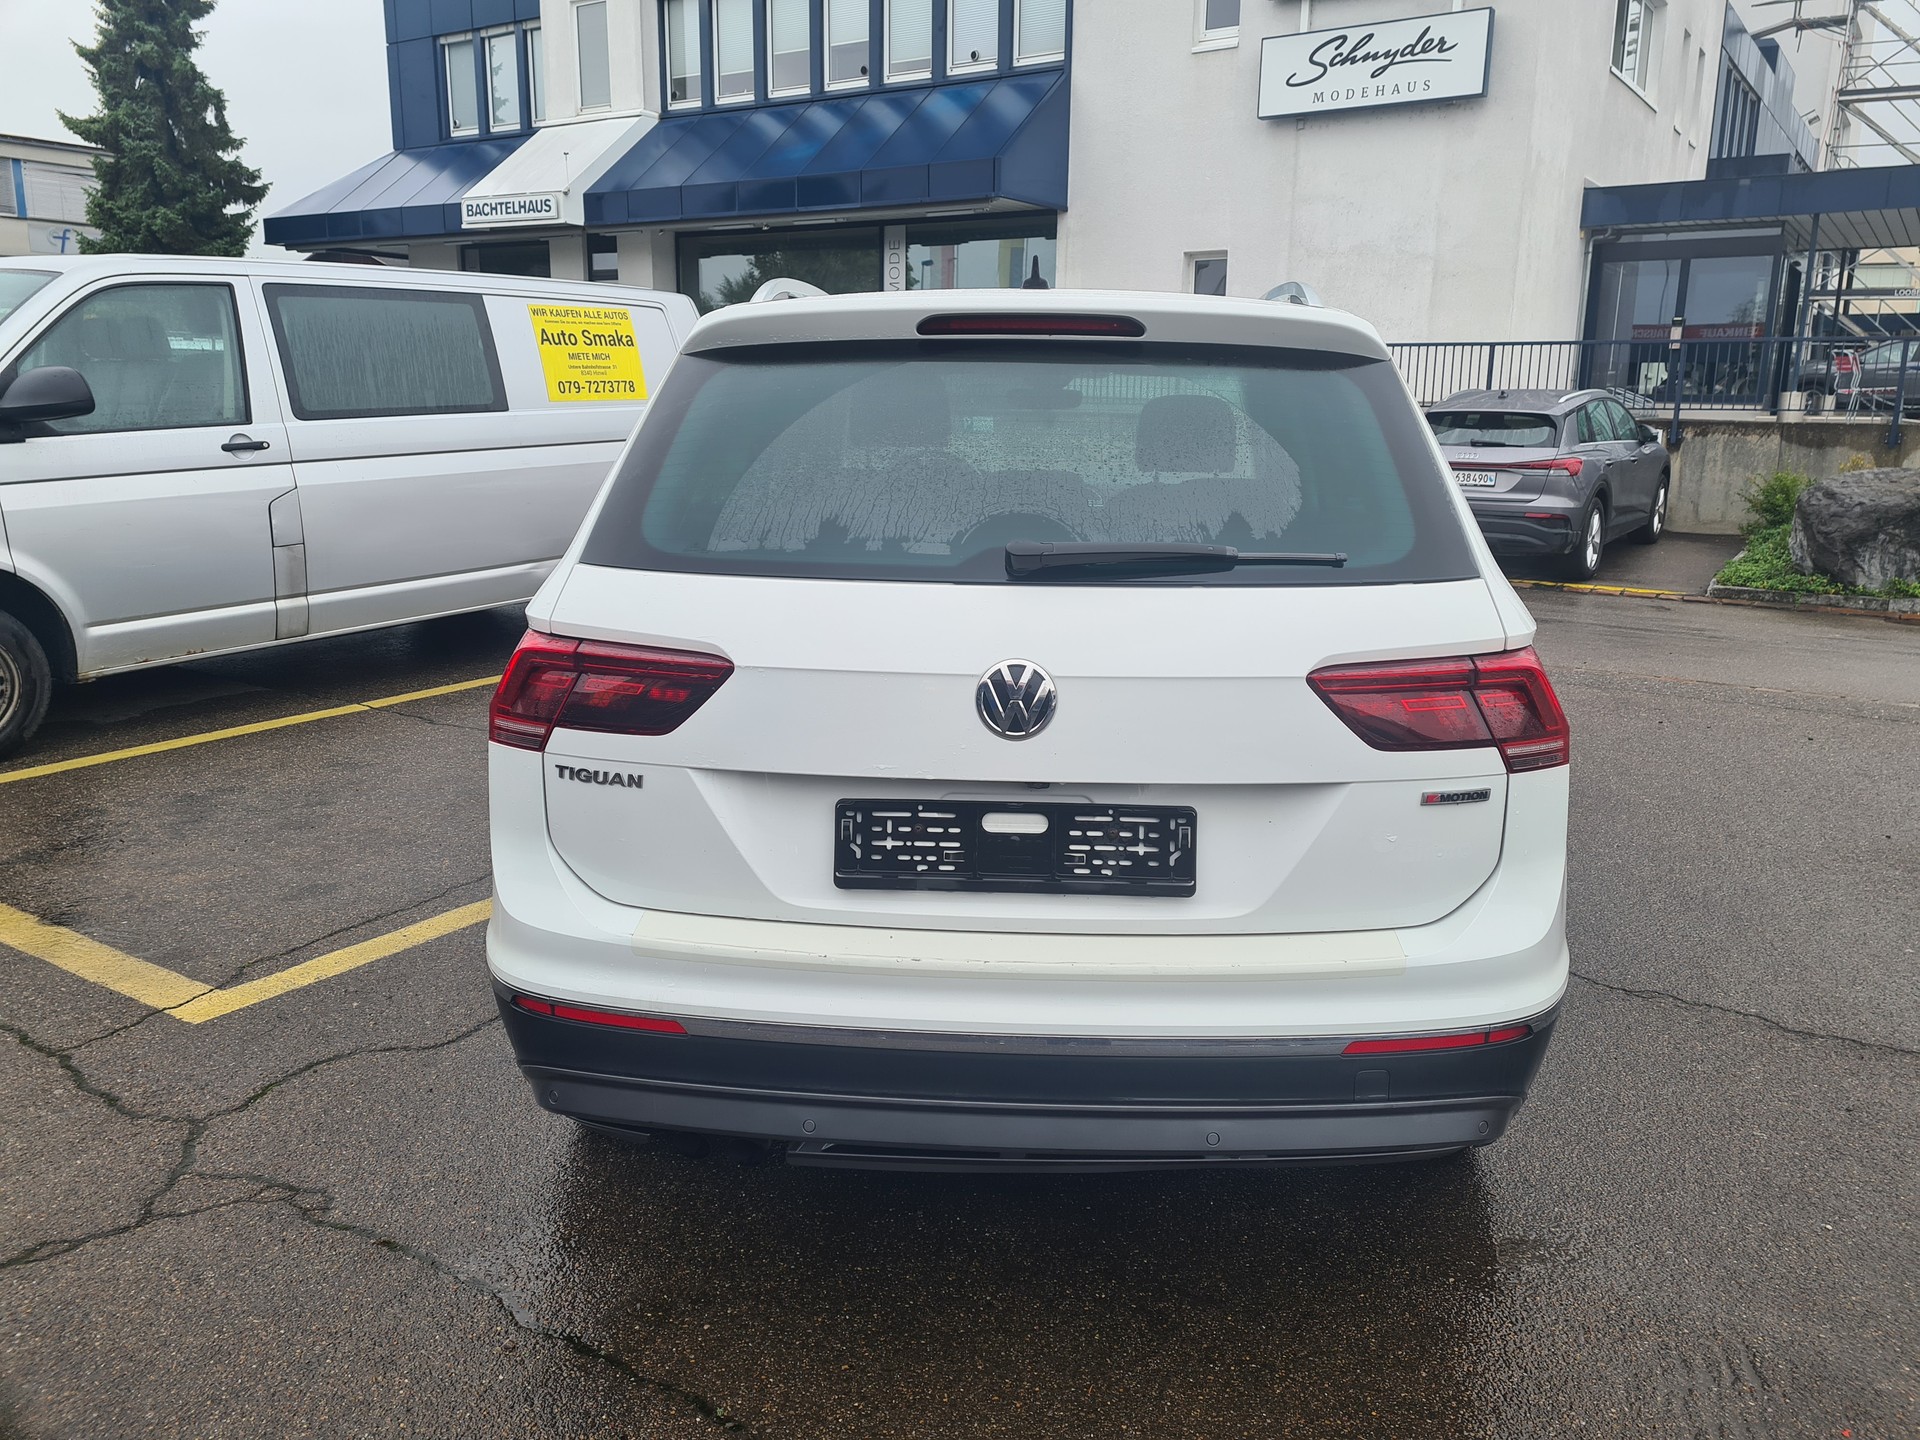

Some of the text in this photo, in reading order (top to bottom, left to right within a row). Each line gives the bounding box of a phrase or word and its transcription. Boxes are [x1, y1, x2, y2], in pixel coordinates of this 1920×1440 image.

[1285, 25, 1459, 88] Schnyder
[1312, 79, 1433, 104] MODEHAUS
[466, 198, 552, 217] BACHTELHAUS
[530, 307, 629, 321] WIR KAUFEN ALLE AUTOS
[540, 328, 635, 348] Auto Smaka
[568, 352, 611, 361] MIETE MICH
[557, 380, 636, 394] 079-7273778
[1455, 472, 1489, 483] 638490
[555, 764, 644, 789] TIGUAN
